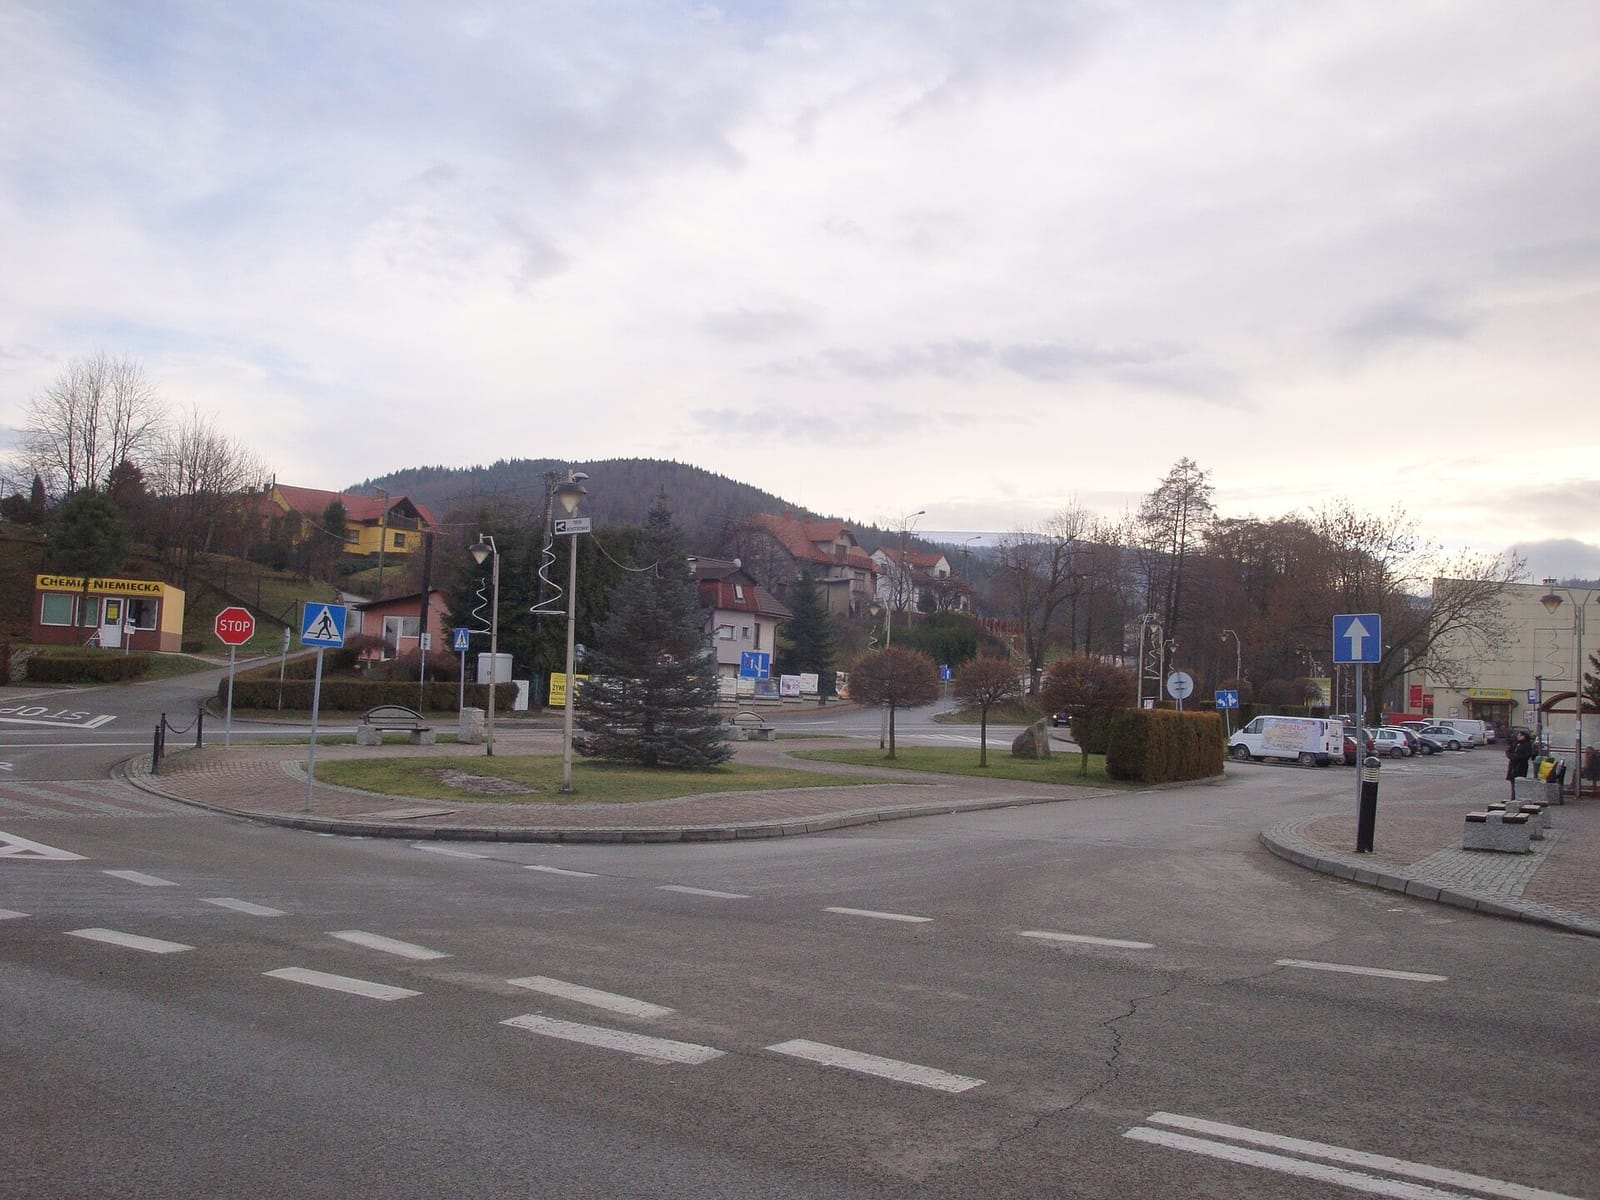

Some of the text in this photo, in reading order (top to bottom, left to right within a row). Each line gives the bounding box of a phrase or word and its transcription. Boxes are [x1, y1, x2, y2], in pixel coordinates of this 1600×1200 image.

[94, 580, 160, 592] NIEMIECKA
[220, 620, 251, 633] STOP
[0, 705, 91, 720] STOP
